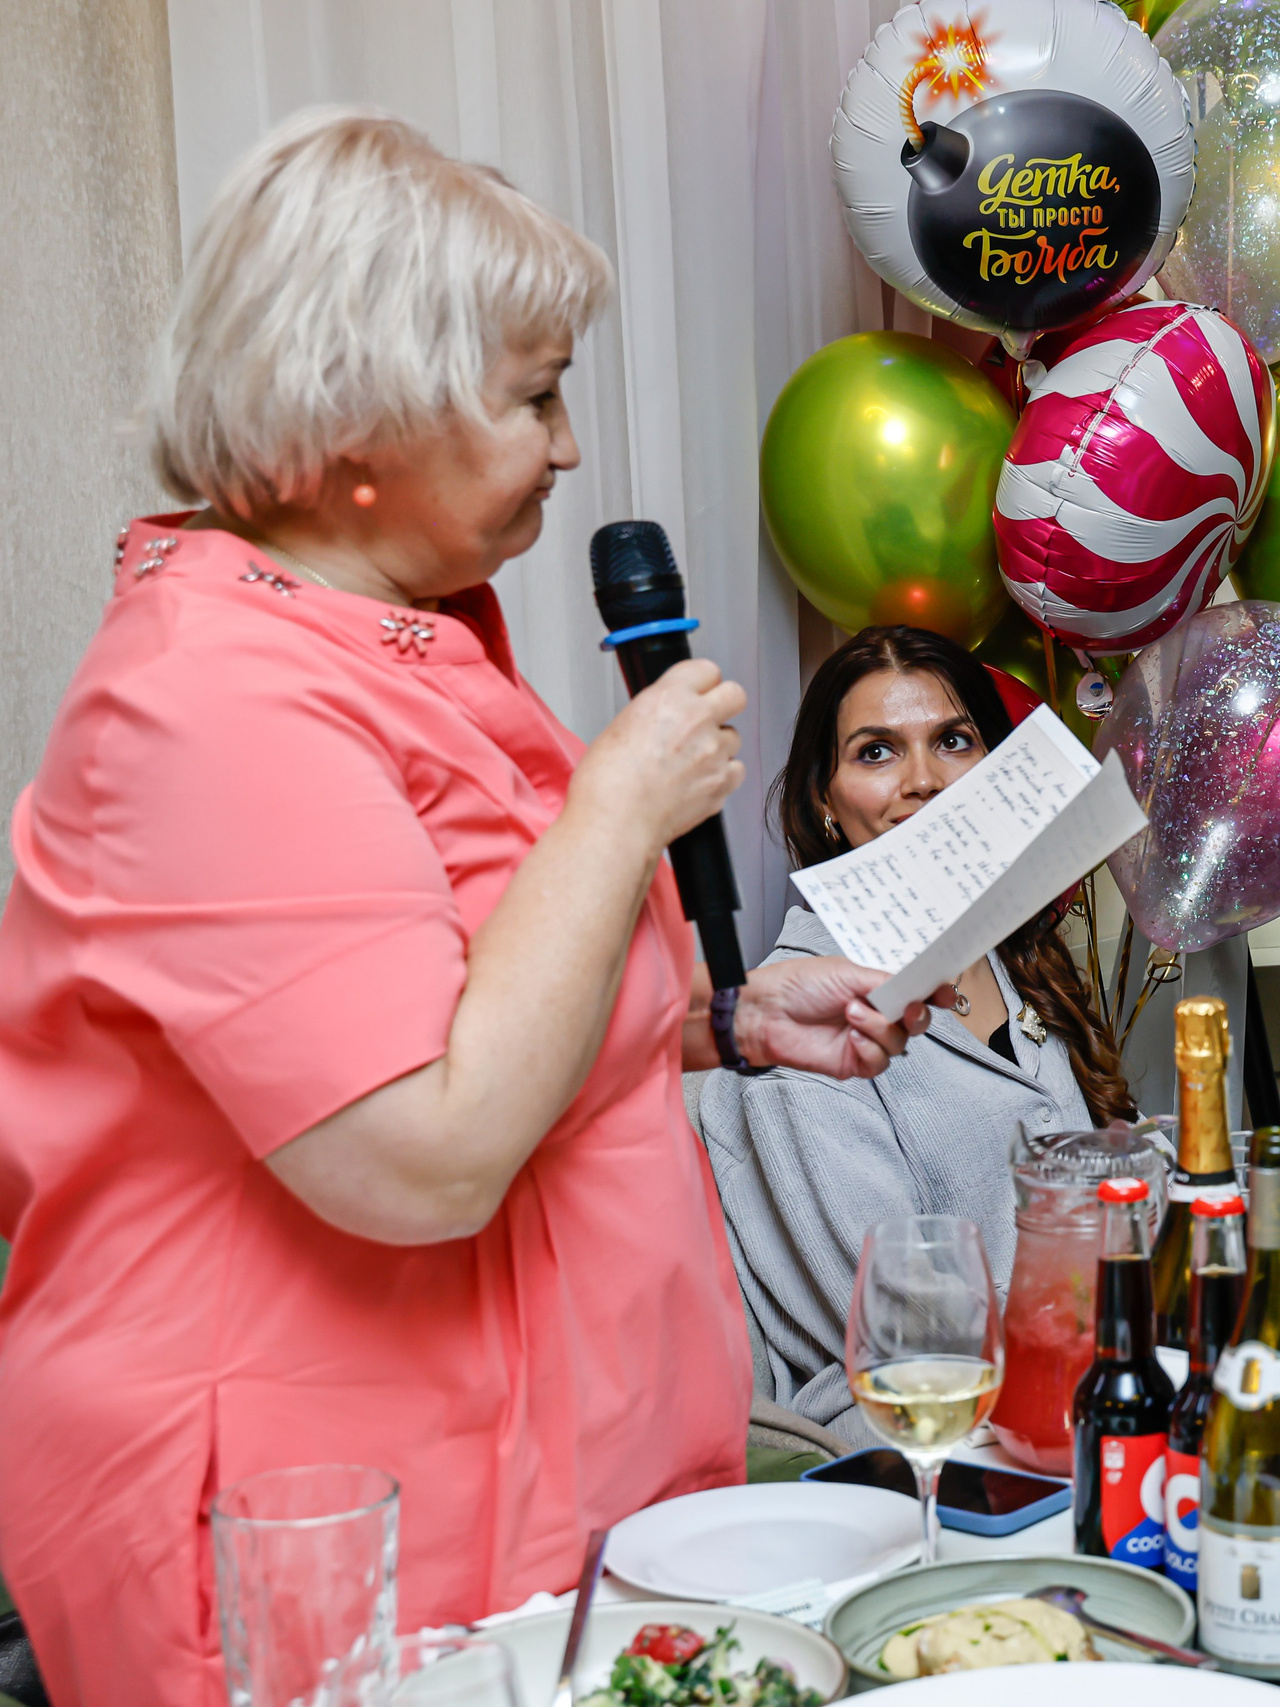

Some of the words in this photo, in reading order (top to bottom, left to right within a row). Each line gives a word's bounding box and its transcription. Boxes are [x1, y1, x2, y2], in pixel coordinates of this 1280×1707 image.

[976, 152, 1121, 215] Детка,
[1033, 205, 1104, 228] ПРОСТО
[962, 226, 1119, 285] Бомба
[1126, 1534, 1165, 1554] COO
